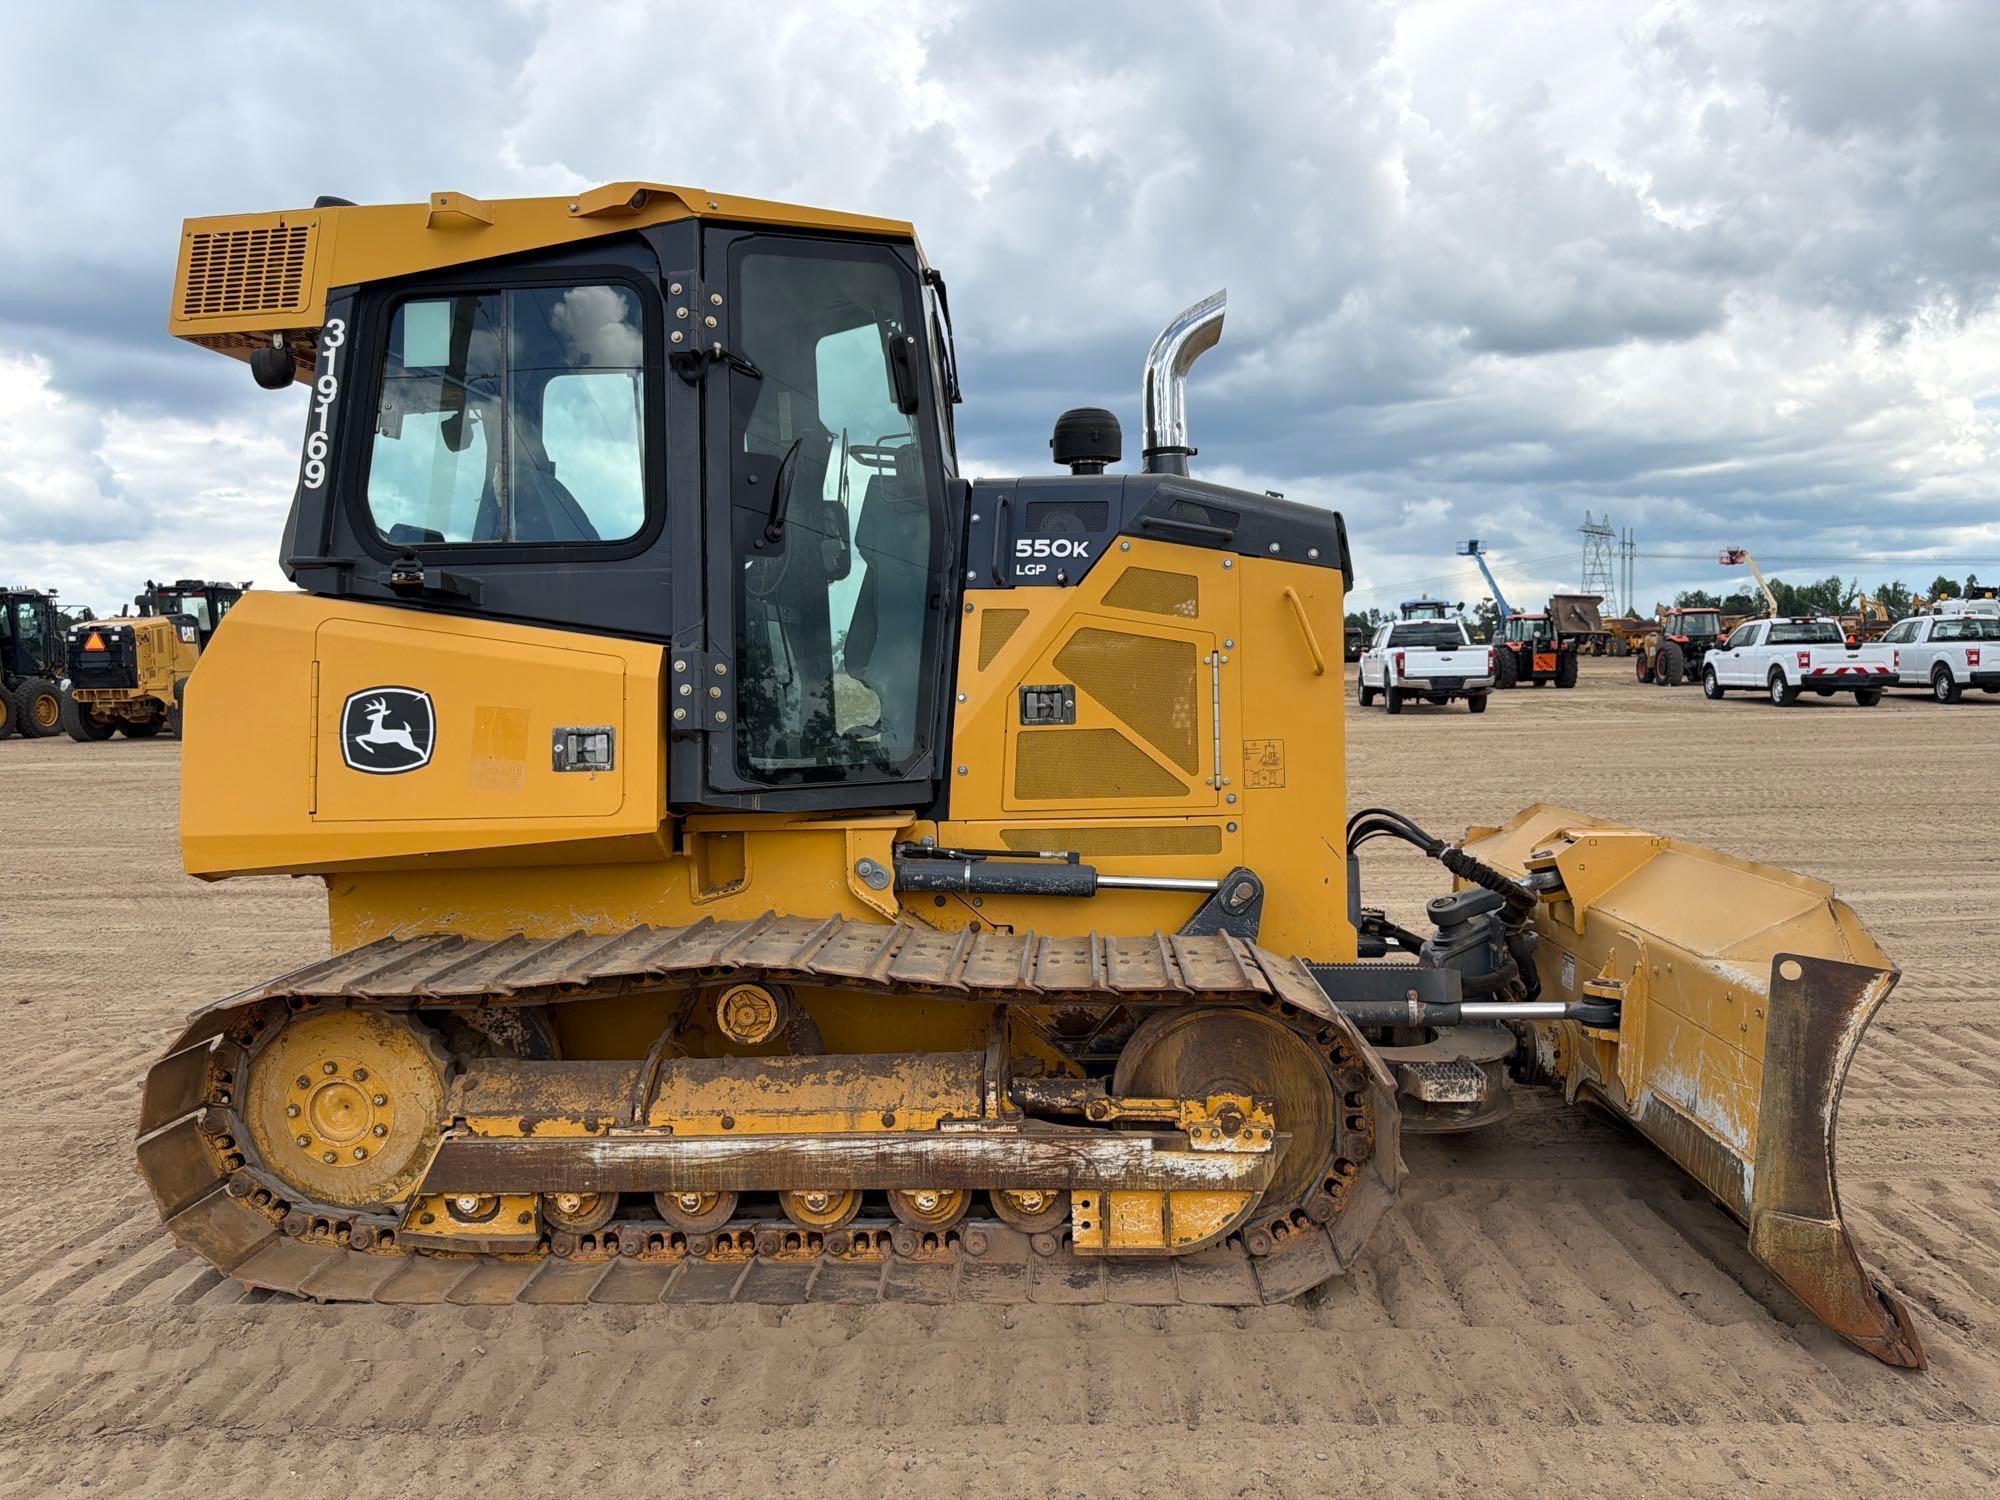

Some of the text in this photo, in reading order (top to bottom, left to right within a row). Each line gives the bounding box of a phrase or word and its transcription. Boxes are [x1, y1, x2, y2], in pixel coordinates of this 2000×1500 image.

[304, 318, 346, 489] 319169
[1015, 539, 1089, 558] 550K
[1015, 564, 1047, 576] LGP
[181, 626, 195, 641] CAT
